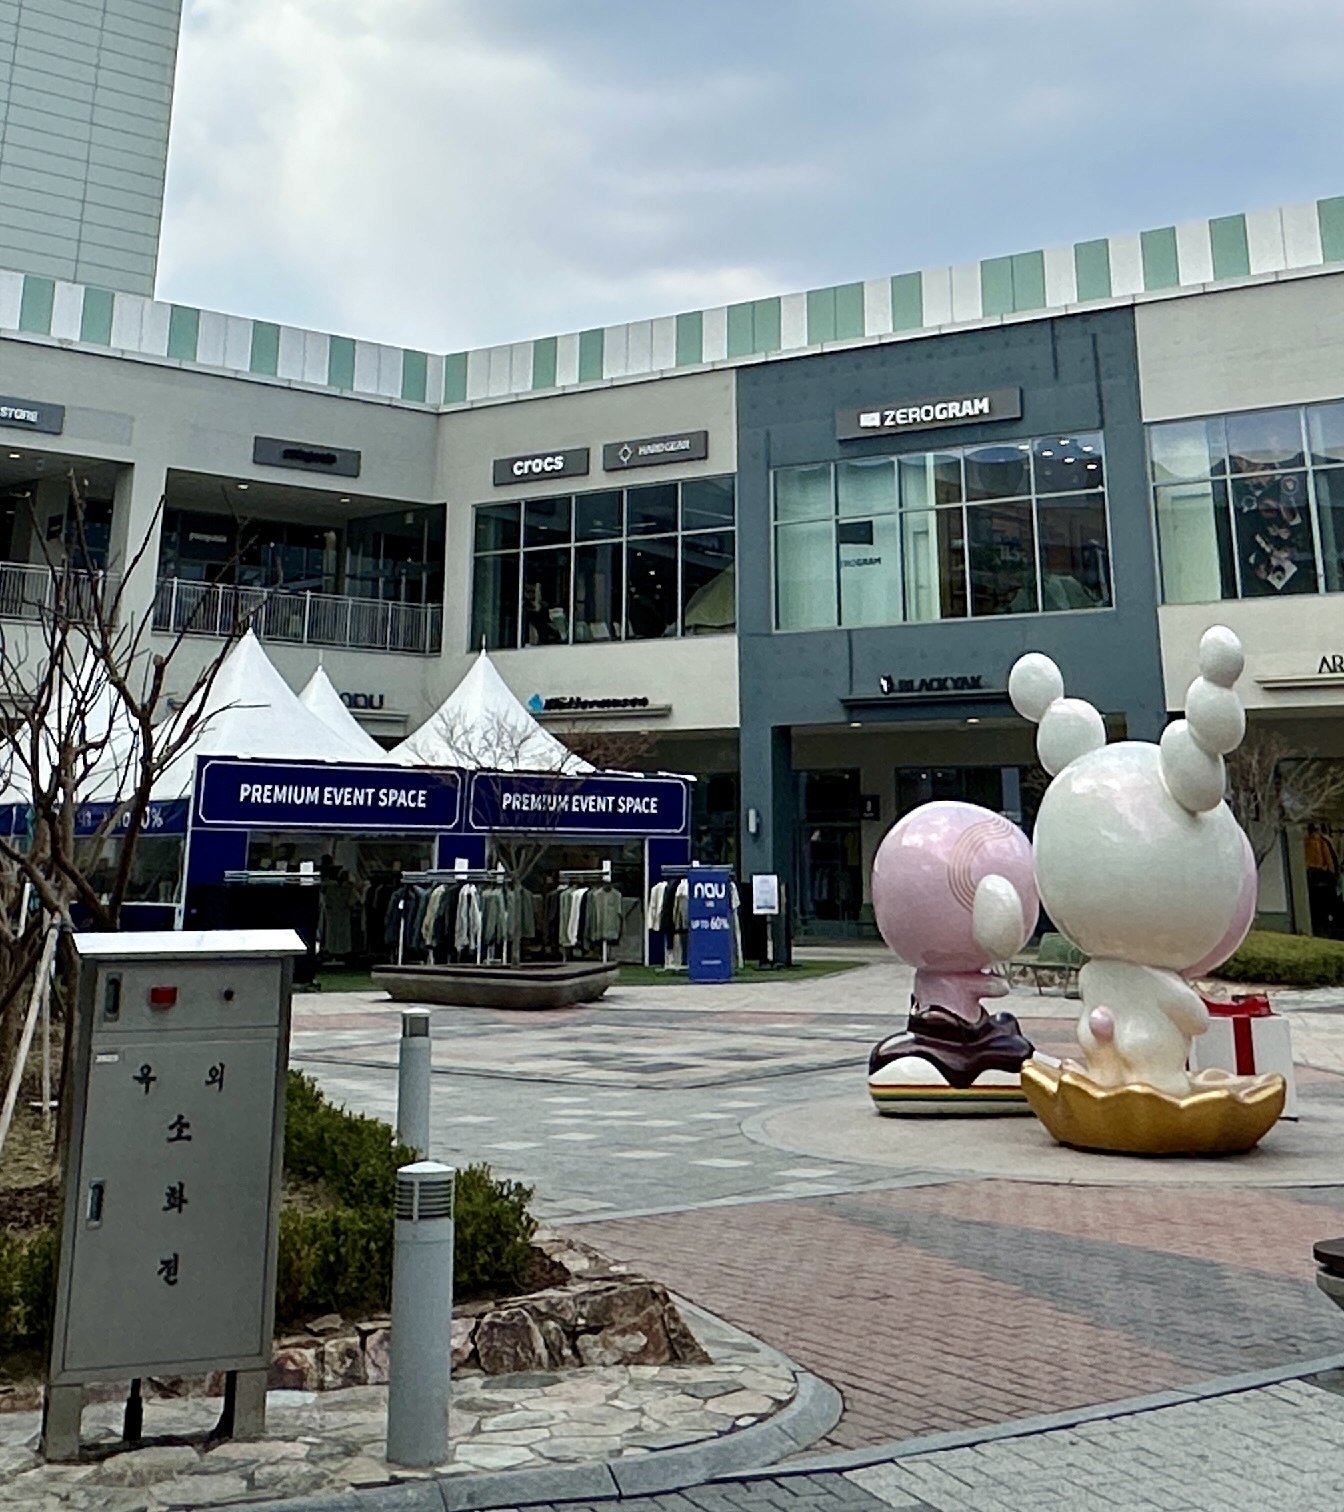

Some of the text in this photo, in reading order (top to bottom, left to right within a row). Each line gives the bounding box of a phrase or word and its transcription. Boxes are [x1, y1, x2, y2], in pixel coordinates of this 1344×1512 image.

[882, 396, 990, 428] ZEROGRAM
[511, 455, 565, 476] crocs
[239, 783, 427, 809] PREMIUM EVENT SPACE
[502, 792, 658, 814] PREMIUM EVENT SPACE
[693, 882, 726, 899] nau
